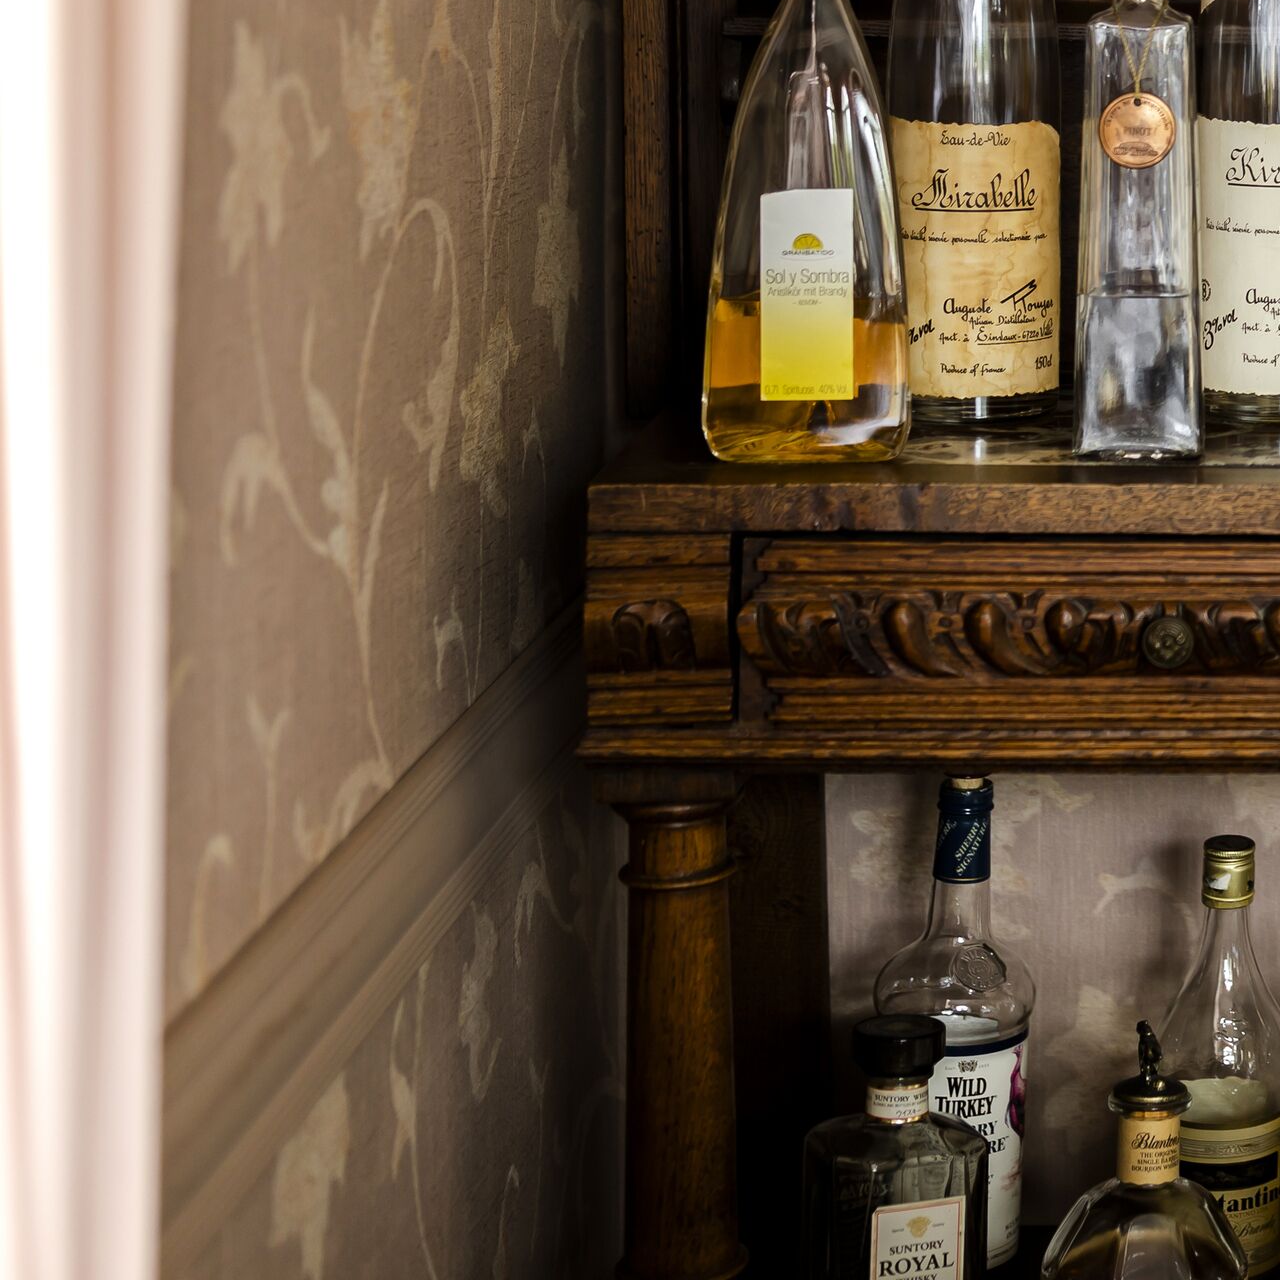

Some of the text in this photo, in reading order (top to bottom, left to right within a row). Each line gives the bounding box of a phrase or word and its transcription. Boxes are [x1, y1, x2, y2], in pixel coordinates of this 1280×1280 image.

[911, 168, 1039, 209] Mirabelle
[765, 268, 850, 288] Sol y Sombra
[803, 286, 817, 297] mit
[818, 285, 848, 298] Brandy
[942, 297, 993, 322] Auguste
[954, 819, 981, 862] SHERRY
[874, 1093, 911, 1103] SUNTORY
[946, 1076, 988, 1099] WILD
[934, 1095, 995, 1120] TURKEY
[1131, 1165, 1162, 1173] BOURBON
[1136, 1158, 1161, 1166] SINGLE
[889, 1239, 945, 1257] SUNTORY
[878, 1251, 955, 1279] ROYAL
